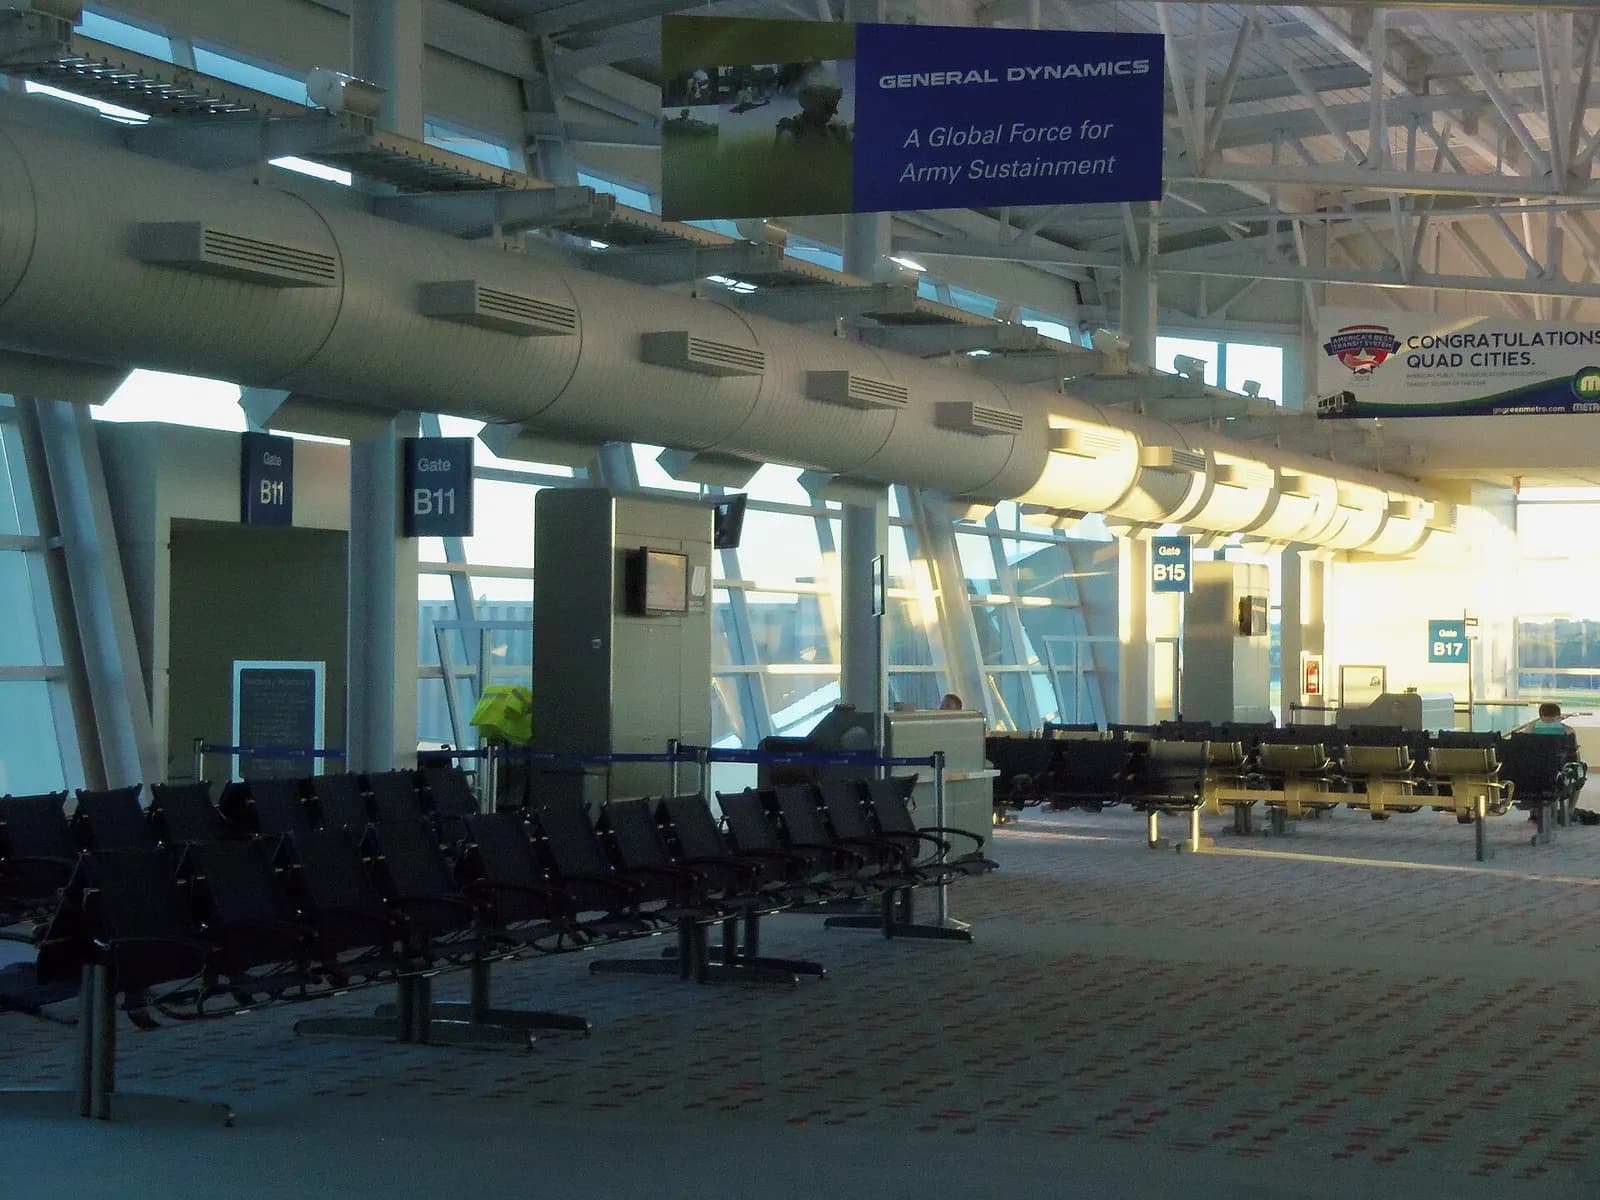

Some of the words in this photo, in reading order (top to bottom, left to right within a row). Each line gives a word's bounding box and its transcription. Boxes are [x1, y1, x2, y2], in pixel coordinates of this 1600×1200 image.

[879, 69, 998, 89] GENERAL
[1007, 59, 1150, 82] DYNAMICS
[903, 129, 921, 149] A
[928, 125, 1002, 148] Global
[1009, 123, 1072, 143] Force
[1079, 119, 1114, 140] for
[899, 163, 962, 185] Army
[967, 156, 1116, 180] Sustainment
[1406, 330, 1600, 349] CONGRATULATIONS
[1406, 352, 1463, 369] QUAD
[1470, 351, 1536, 368] CITIES.
[263, 451, 282, 467] Gate
[417, 457, 452, 472] Gate
[260, 480, 284, 505] B11
[413, 488, 455, 515] B11
[1158, 545, 1181, 556] Gate
[1153, 563, 1186, 581] B15
[1433, 641, 1464, 657] B17
